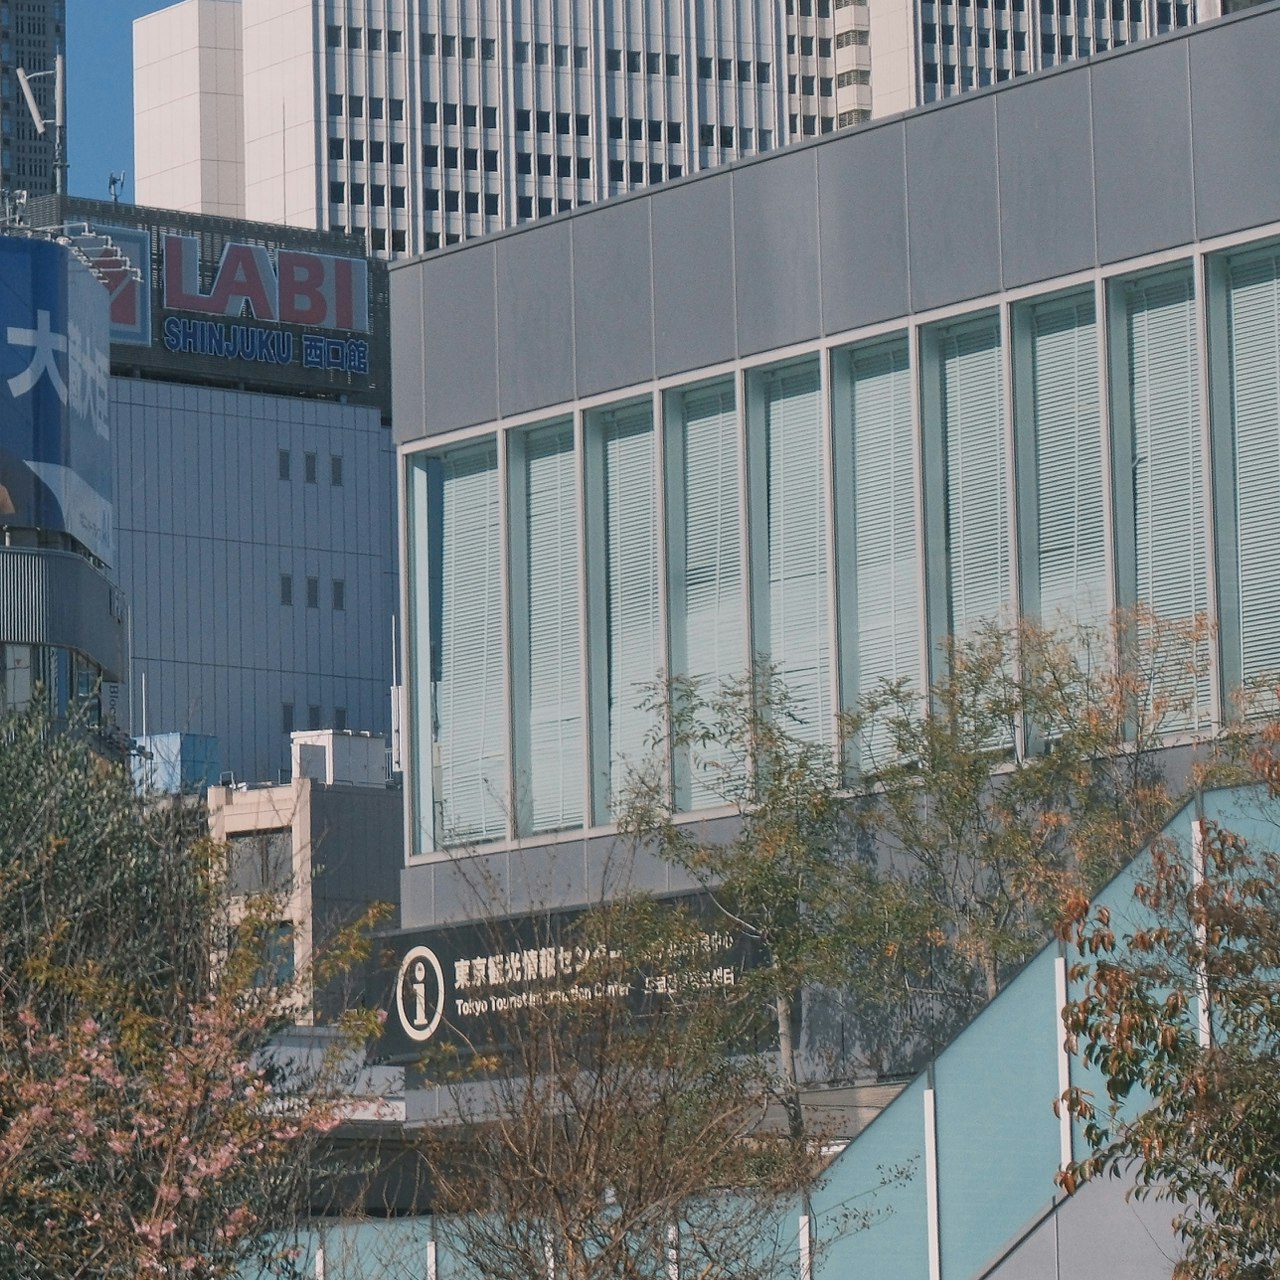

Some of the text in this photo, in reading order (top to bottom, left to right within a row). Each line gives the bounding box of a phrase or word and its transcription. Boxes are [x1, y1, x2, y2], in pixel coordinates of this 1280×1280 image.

[163, 233, 369, 333] LABI
[163, 316, 369, 375] SHINJUKU 西口館
[455, 999, 488, 1017] Tokyo
